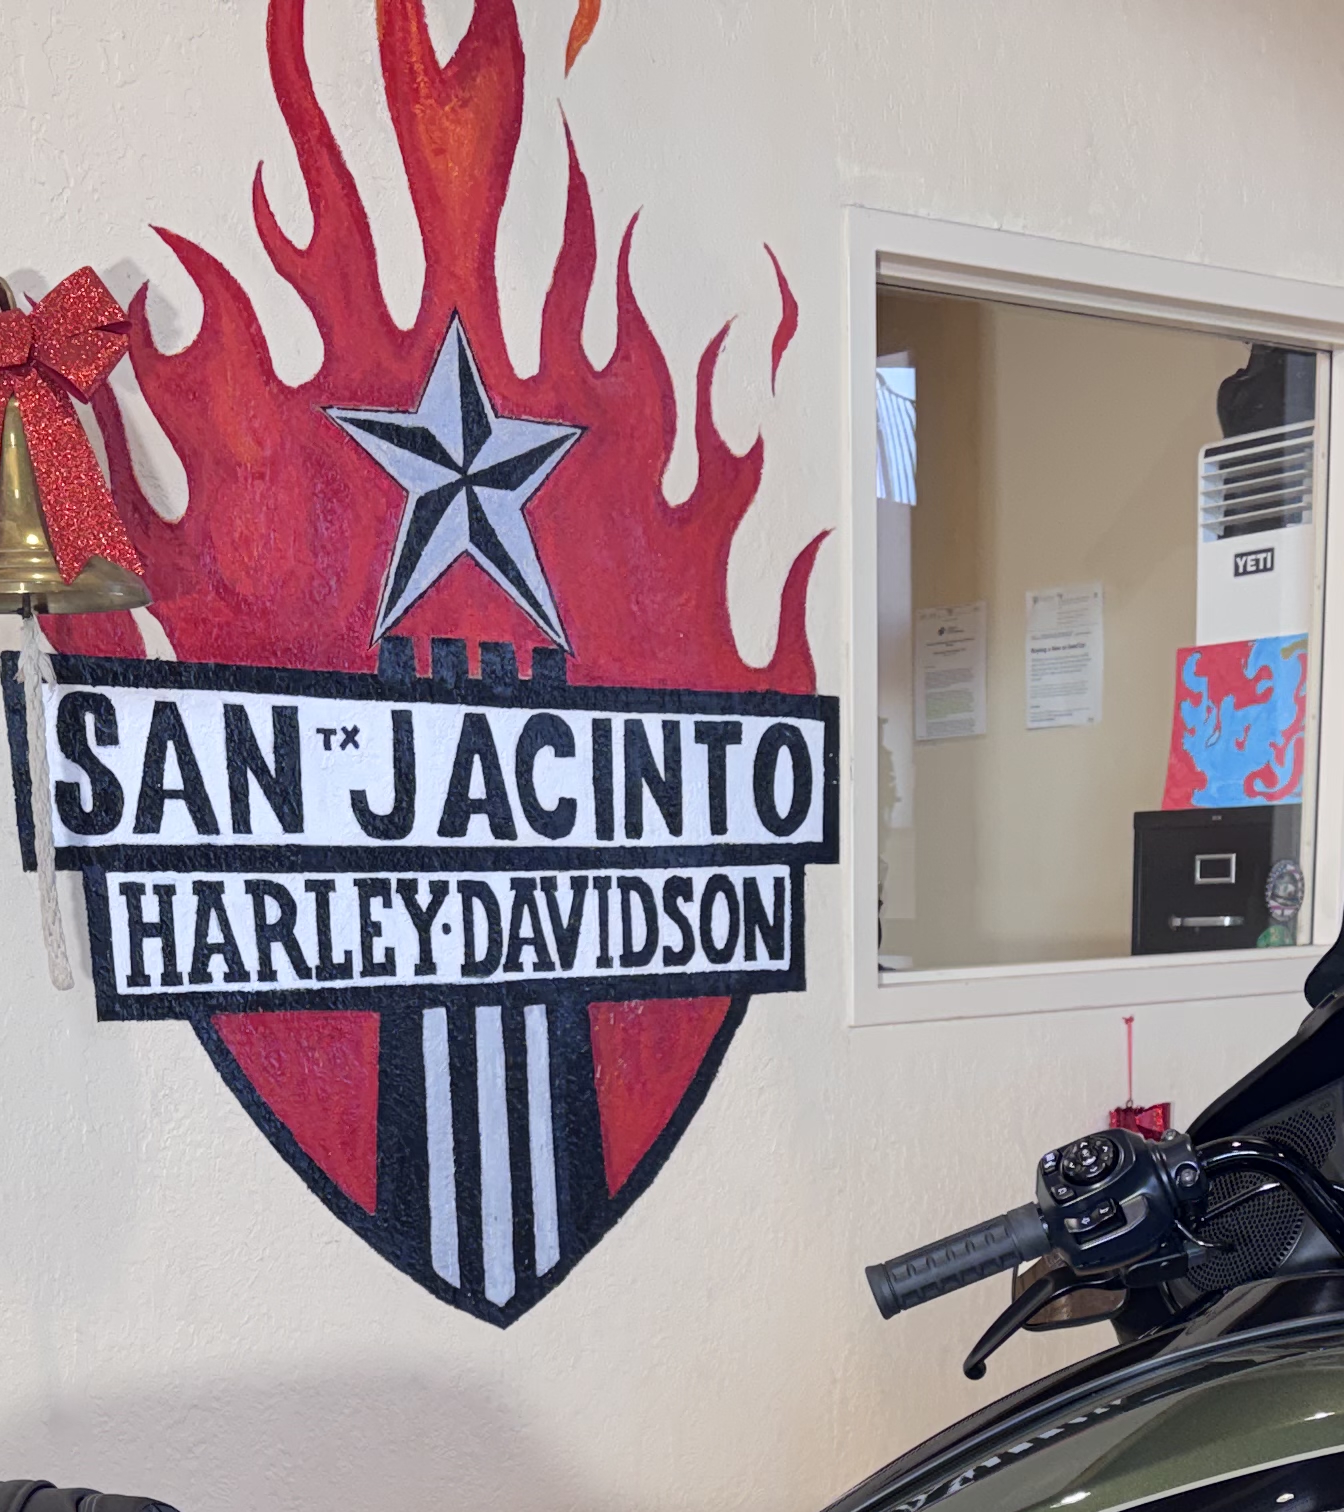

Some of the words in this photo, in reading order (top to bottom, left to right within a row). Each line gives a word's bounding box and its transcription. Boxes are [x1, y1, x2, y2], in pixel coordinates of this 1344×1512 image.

[1236, 551, 1272, 573] YETI
[55, 691, 303, 836] SAN
[316, 725, 360, 751] TX
[349, 709, 814, 841] JACINTO
